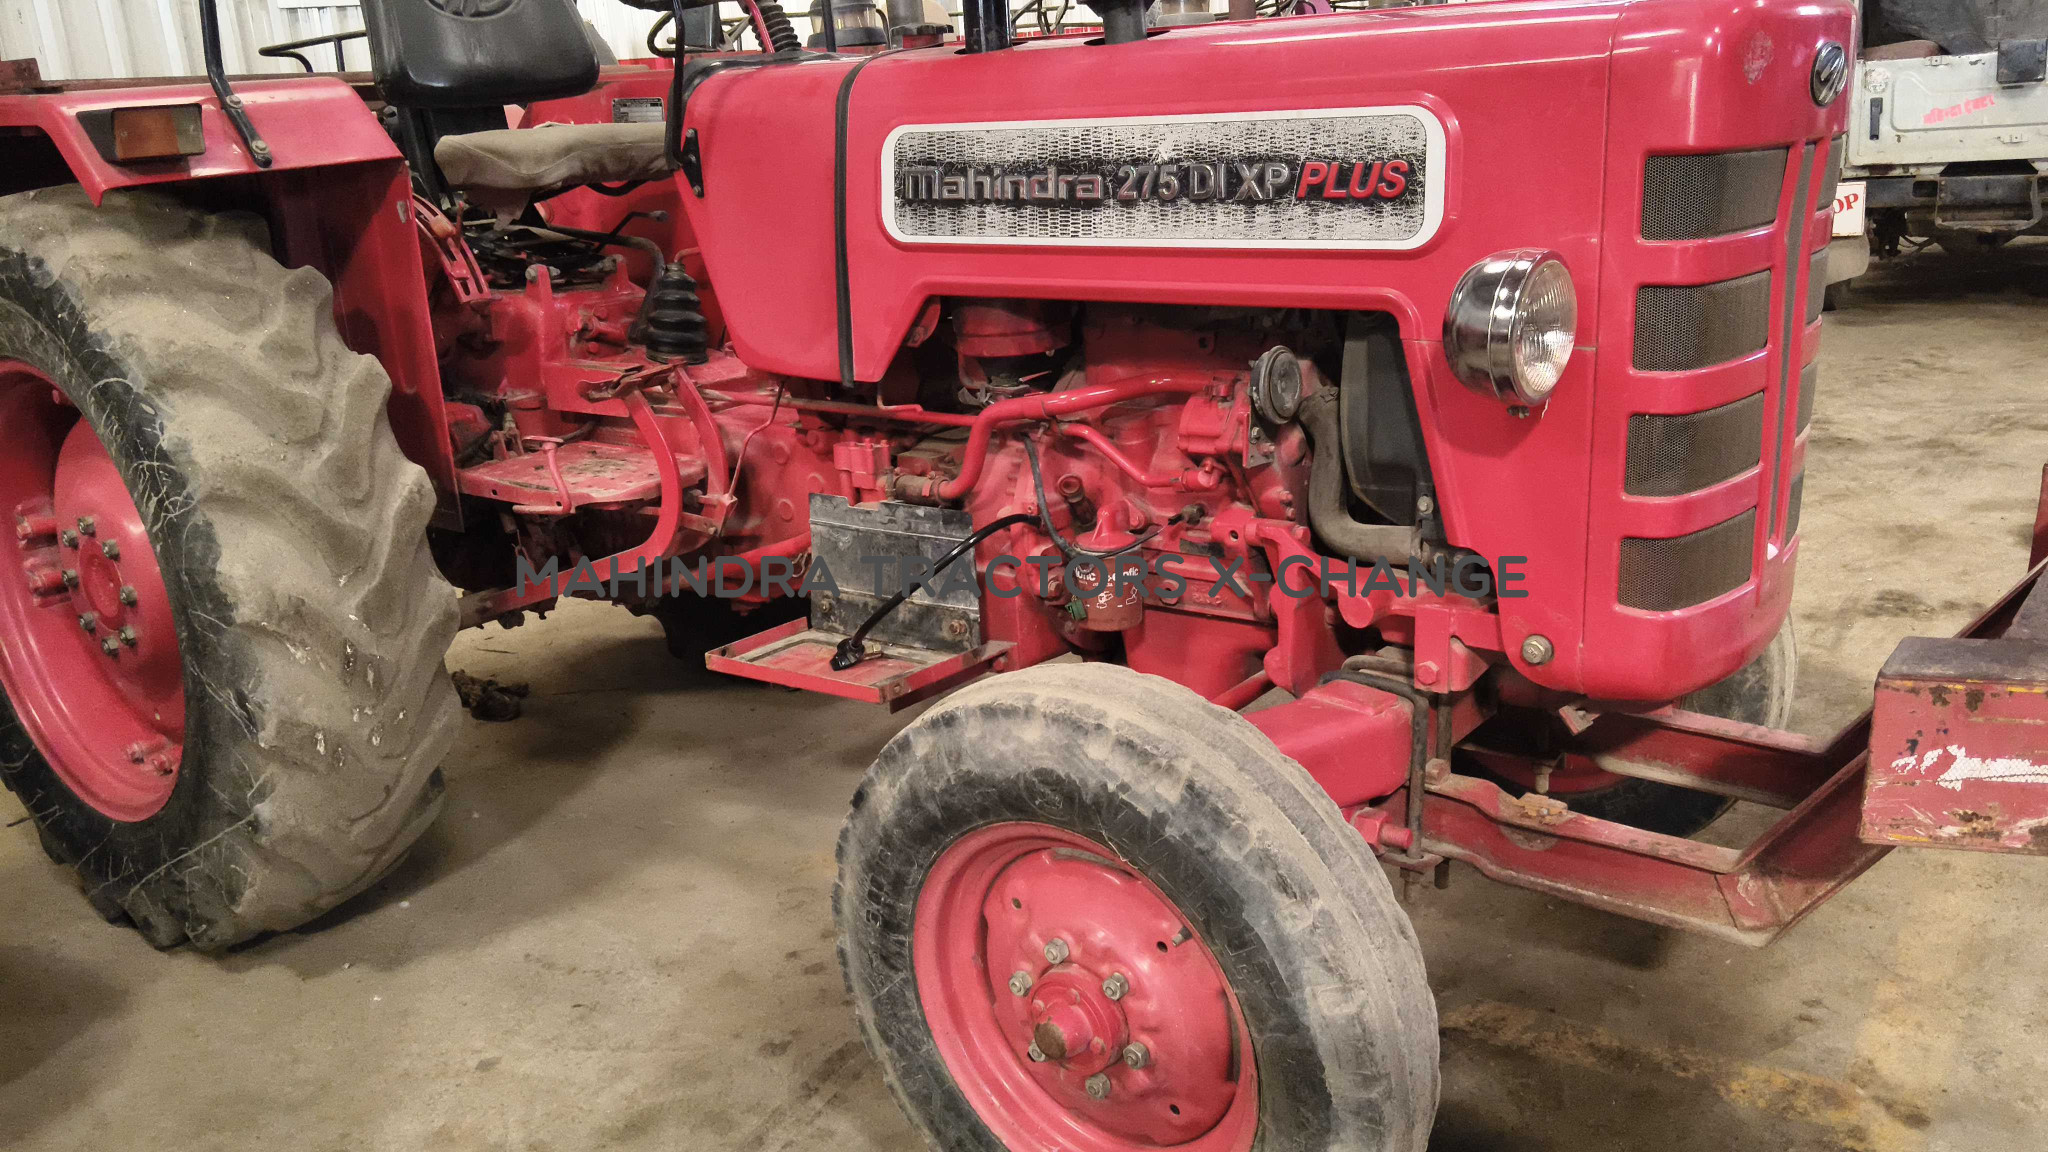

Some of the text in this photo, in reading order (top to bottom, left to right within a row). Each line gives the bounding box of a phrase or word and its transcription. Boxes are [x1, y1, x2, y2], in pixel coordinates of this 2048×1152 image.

[904, 163, 1104, 200] Mahindra
[1116, 163, 1181, 201] 275
[1296, 159, 1410, 199] PLUS
